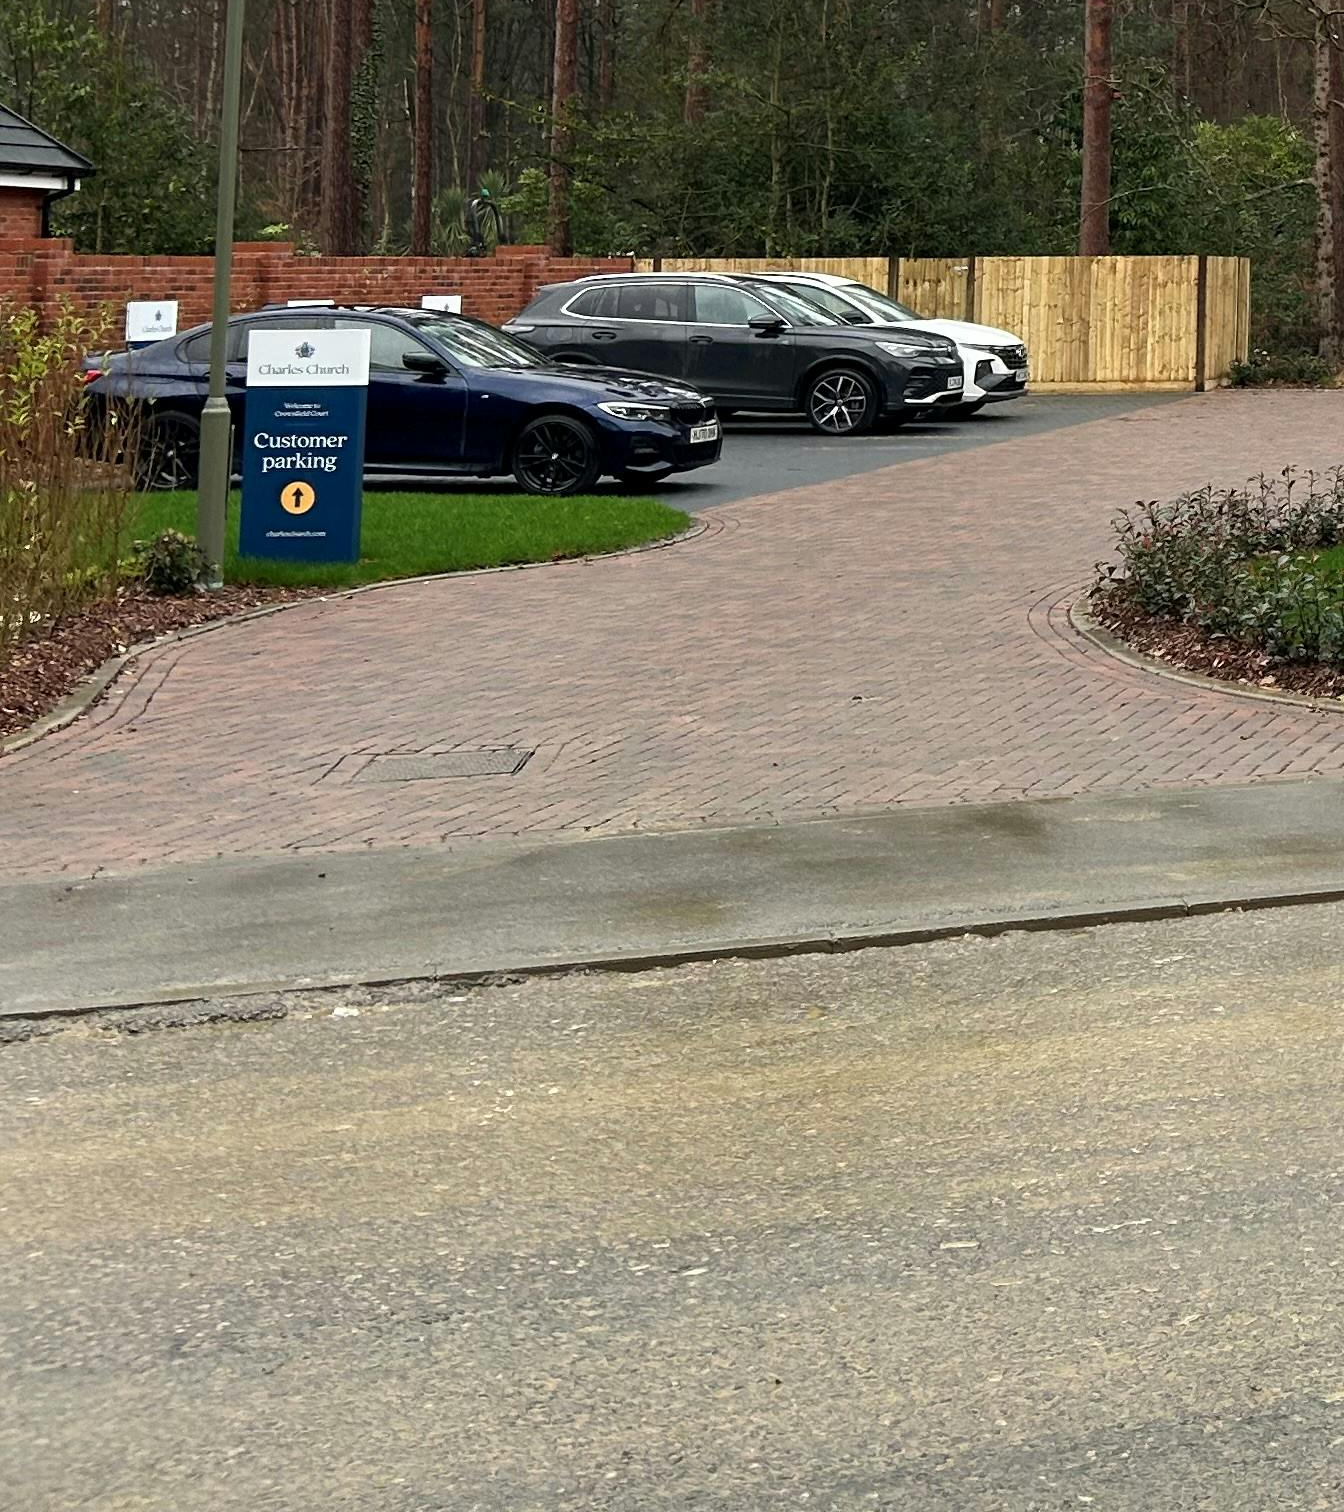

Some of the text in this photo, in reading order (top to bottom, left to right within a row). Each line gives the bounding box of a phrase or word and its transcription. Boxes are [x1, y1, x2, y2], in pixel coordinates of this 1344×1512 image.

[259, 364, 349, 375] Charles Church
[253, 432, 348, 449] Customer
[261, 452, 338, 473] parking
